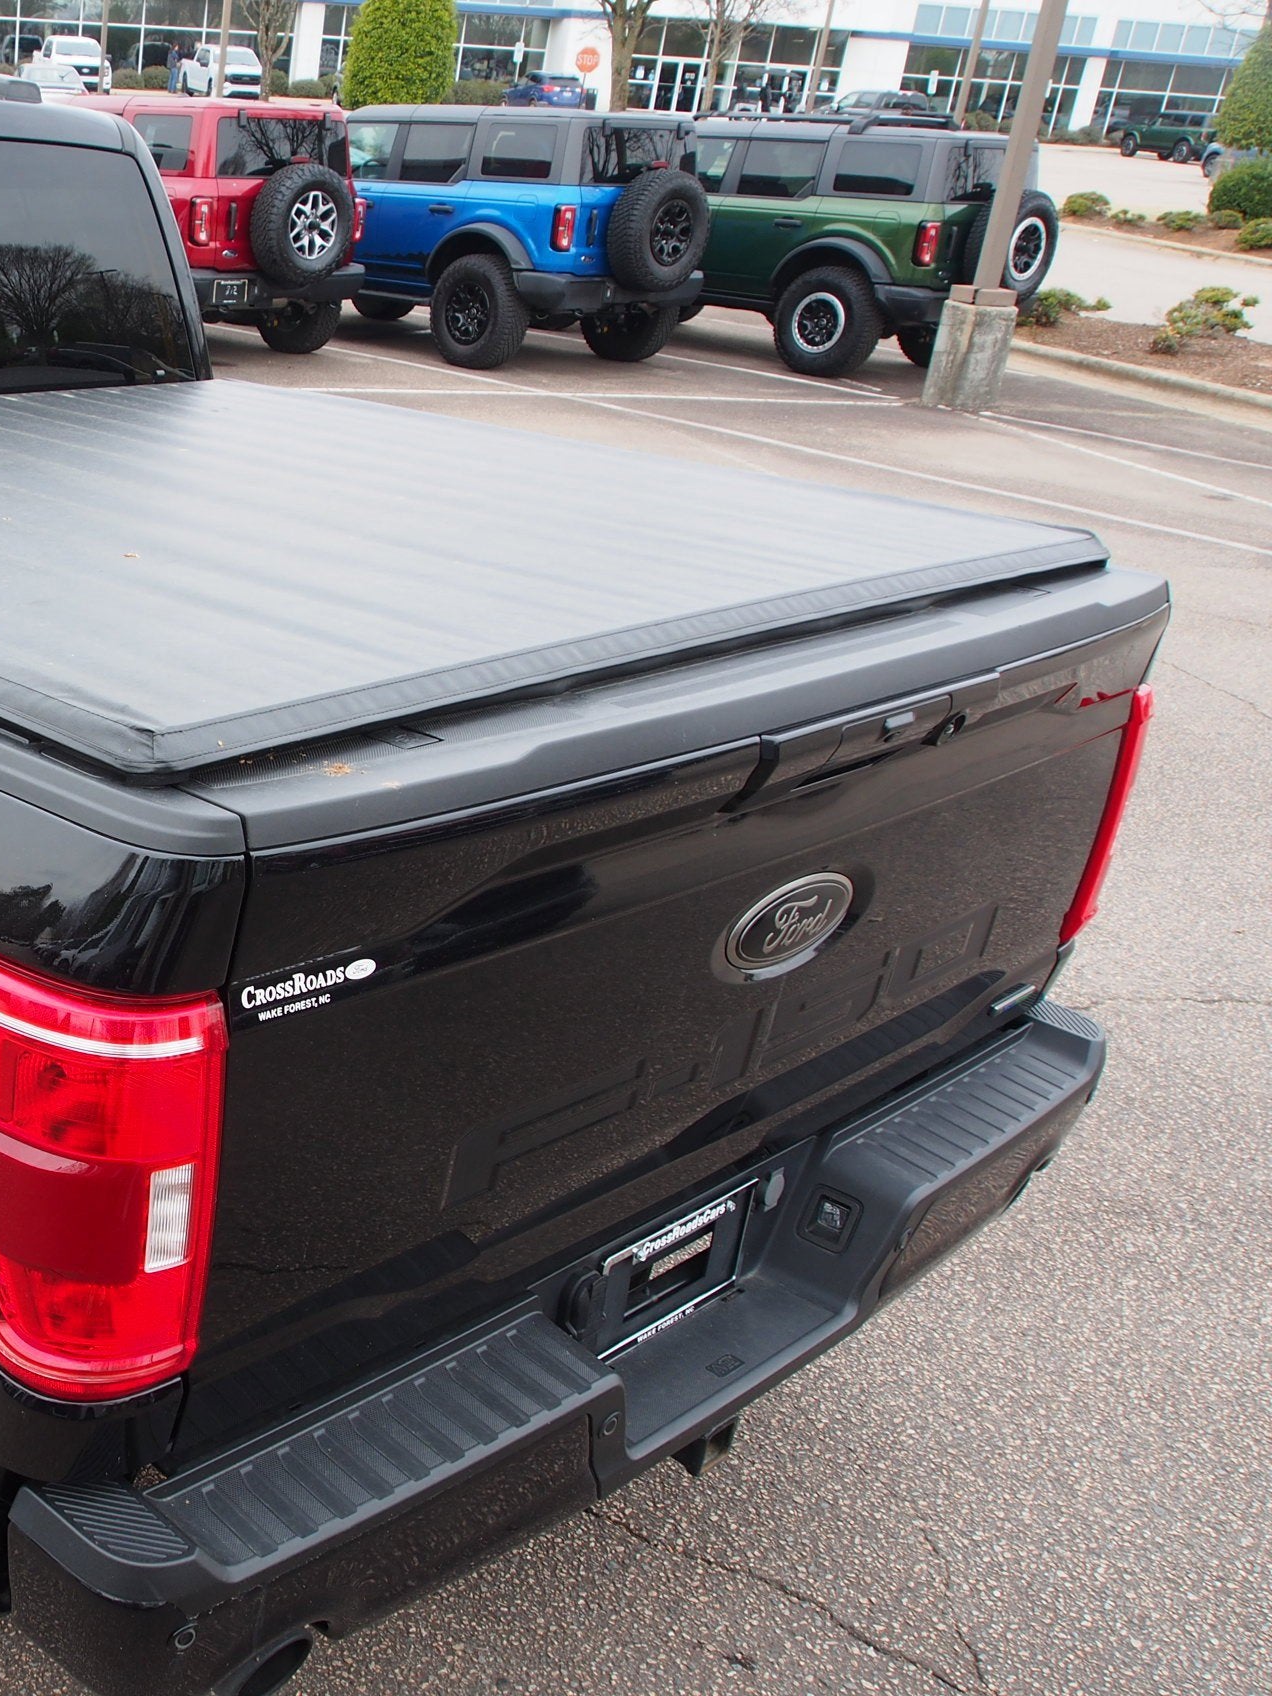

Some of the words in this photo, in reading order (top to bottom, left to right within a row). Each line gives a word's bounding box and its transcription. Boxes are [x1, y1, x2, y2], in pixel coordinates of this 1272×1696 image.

[577, 54, 599, 66] STOP
[763, 895, 833, 954] Ford
[258, 1006, 283, 1022] WAKE
[284, 997, 318, 1016] FOREST,
[318, 993, 331, 1005] NC
[637, 1327, 657, 1343] WAKE
[685, 1305, 695, 1315] NC
